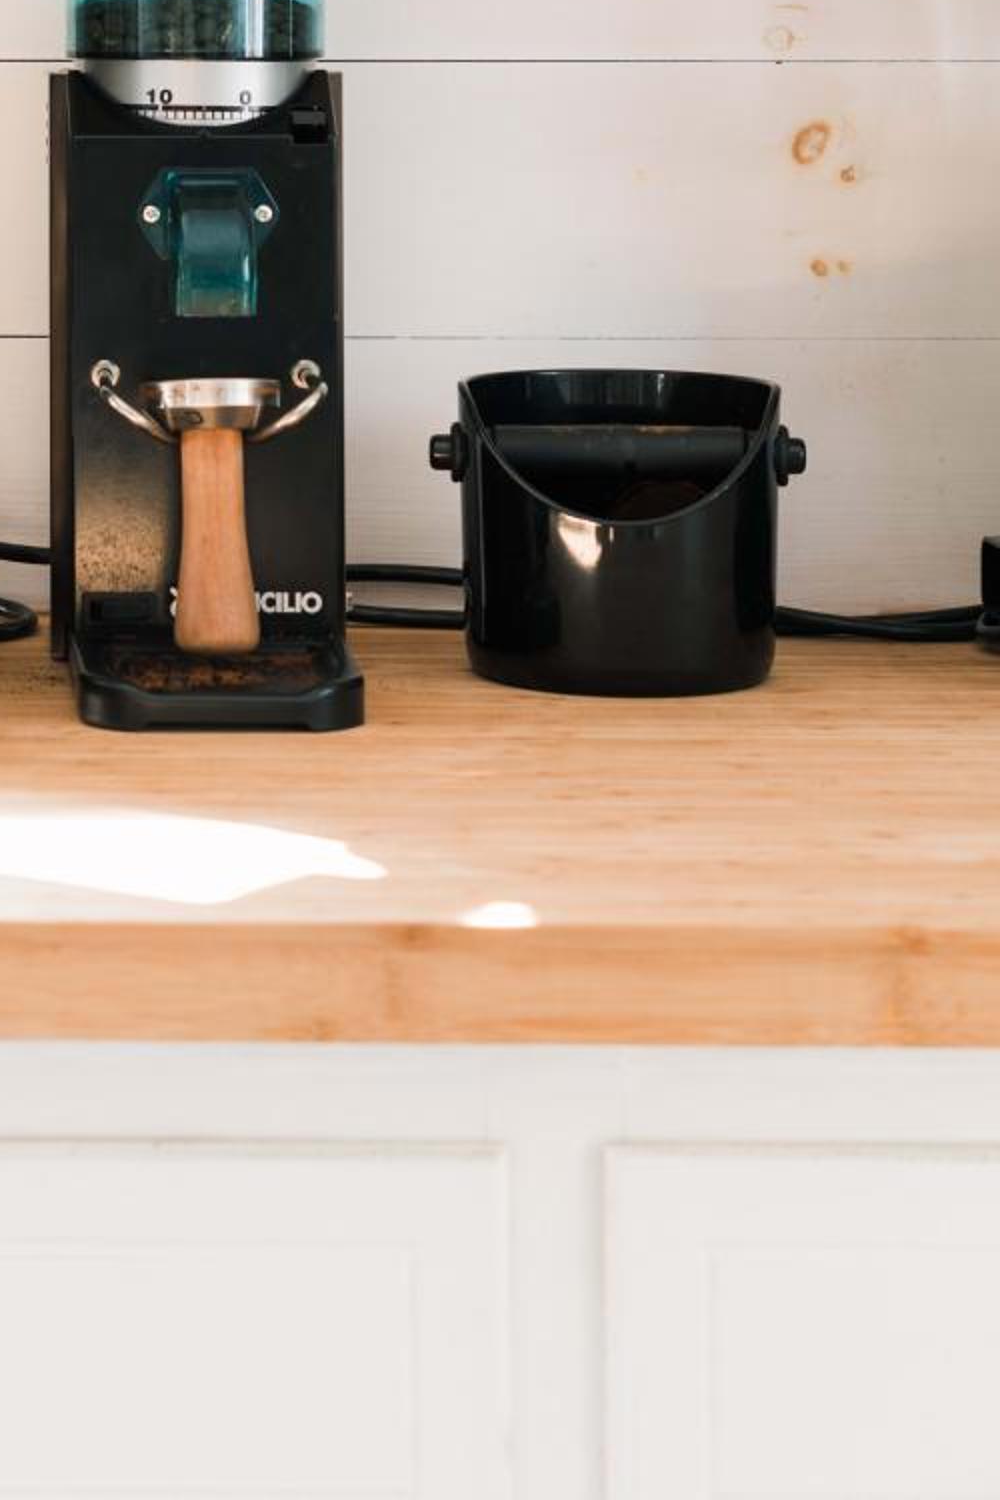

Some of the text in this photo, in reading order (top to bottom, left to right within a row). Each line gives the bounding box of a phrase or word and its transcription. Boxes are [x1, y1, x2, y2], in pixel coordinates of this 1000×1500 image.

[146, 89, 252, 105] 10 0
[255, 591, 323, 614] CILIO
